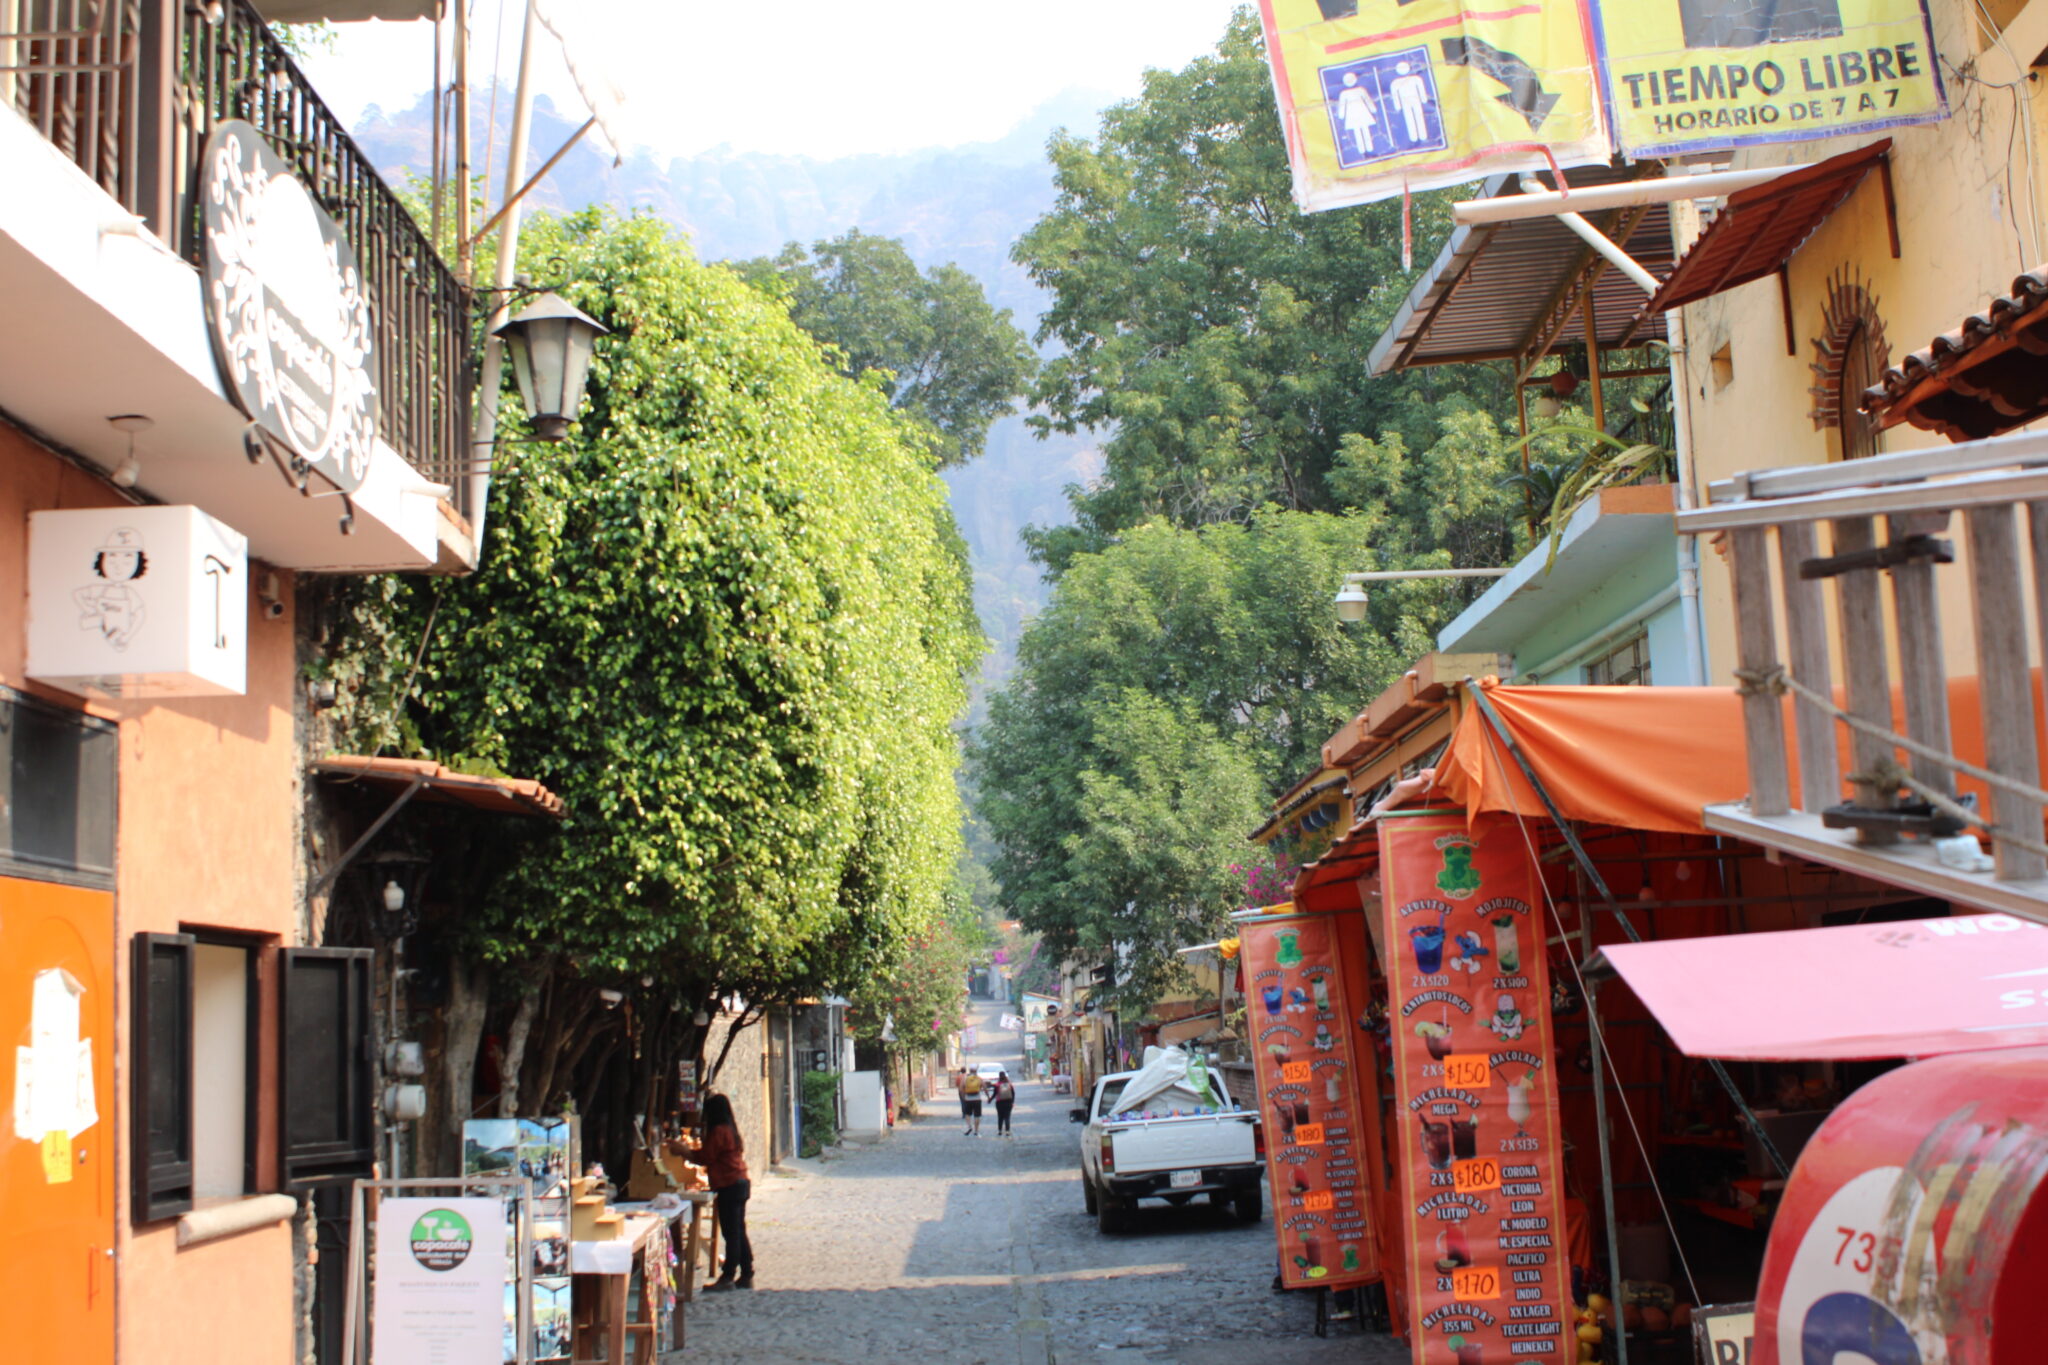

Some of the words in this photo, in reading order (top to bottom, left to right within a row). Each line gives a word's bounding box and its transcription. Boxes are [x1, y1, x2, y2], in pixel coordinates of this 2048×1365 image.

[1622, 59, 1786, 109] TIEMPO
[1799, 42, 1921, 93] LIBRE
[1654, 103, 1780, 134] HORARIO
[1789, 100, 1824, 121] DE
[1830, 96, 1847, 116] 7
[1857, 92, 1878, 112] A
[1884, 88, 1900, 108] 7
[1400, 900, 1453, 918] AZULITOS
[1475, 899, 1531, 918] MOJOJITOS
[1505, 1051, 1542, 1070] COLADA
[1284, 1064, 1309, 1080] $150
[1445, 1063, 1486, 1085] $150
[1408, 1087, 1480, 1112] MICHELADAS
[1432, 1103, 1459, 1116] MEGA
[1455, 1162, 1496, 1188] $180
[1502, 1166, 1539, 1179] CORONA
[1501, 1183, 1542, 1196] VICTORIA
[1416, 1193, 1488, 1217] MICHELADAS
[1511, 1200, 1535, 1213] LEON
[1441, 1207, 1469, 1219] LITRO
[1501, 1220, 1511, 1231] N.
[1512, 1217, 1548, 1230] MODELO
[1499, 1236, 1510, 1248] M.
[1511, 1235, 1551, 1248] ESPECIAL
[1507, 1252, 1546, 1265] PACIFICO
[1513, 1270, 1541, 1283] ULTRA
[1455, 1273, 1494, 1296] $170
[1516, 1287, 1541, 1300] INDIO
[1421, 1303, 1496, 1330] MICHELADAS
[1509, 1306, 1522, 1318] XX
[1522, 1304, 1551, 1318] LAGER
[1442, 1321, 1459, 1333] 355
[1460, 1320, 1475, 1332] ML
[1502, 1323, 1535, 1337] TECATE
[1535, 1321, 1561, 1335] LIGHT
[1511, 1340, 1555, 1354] HEINEKEN
